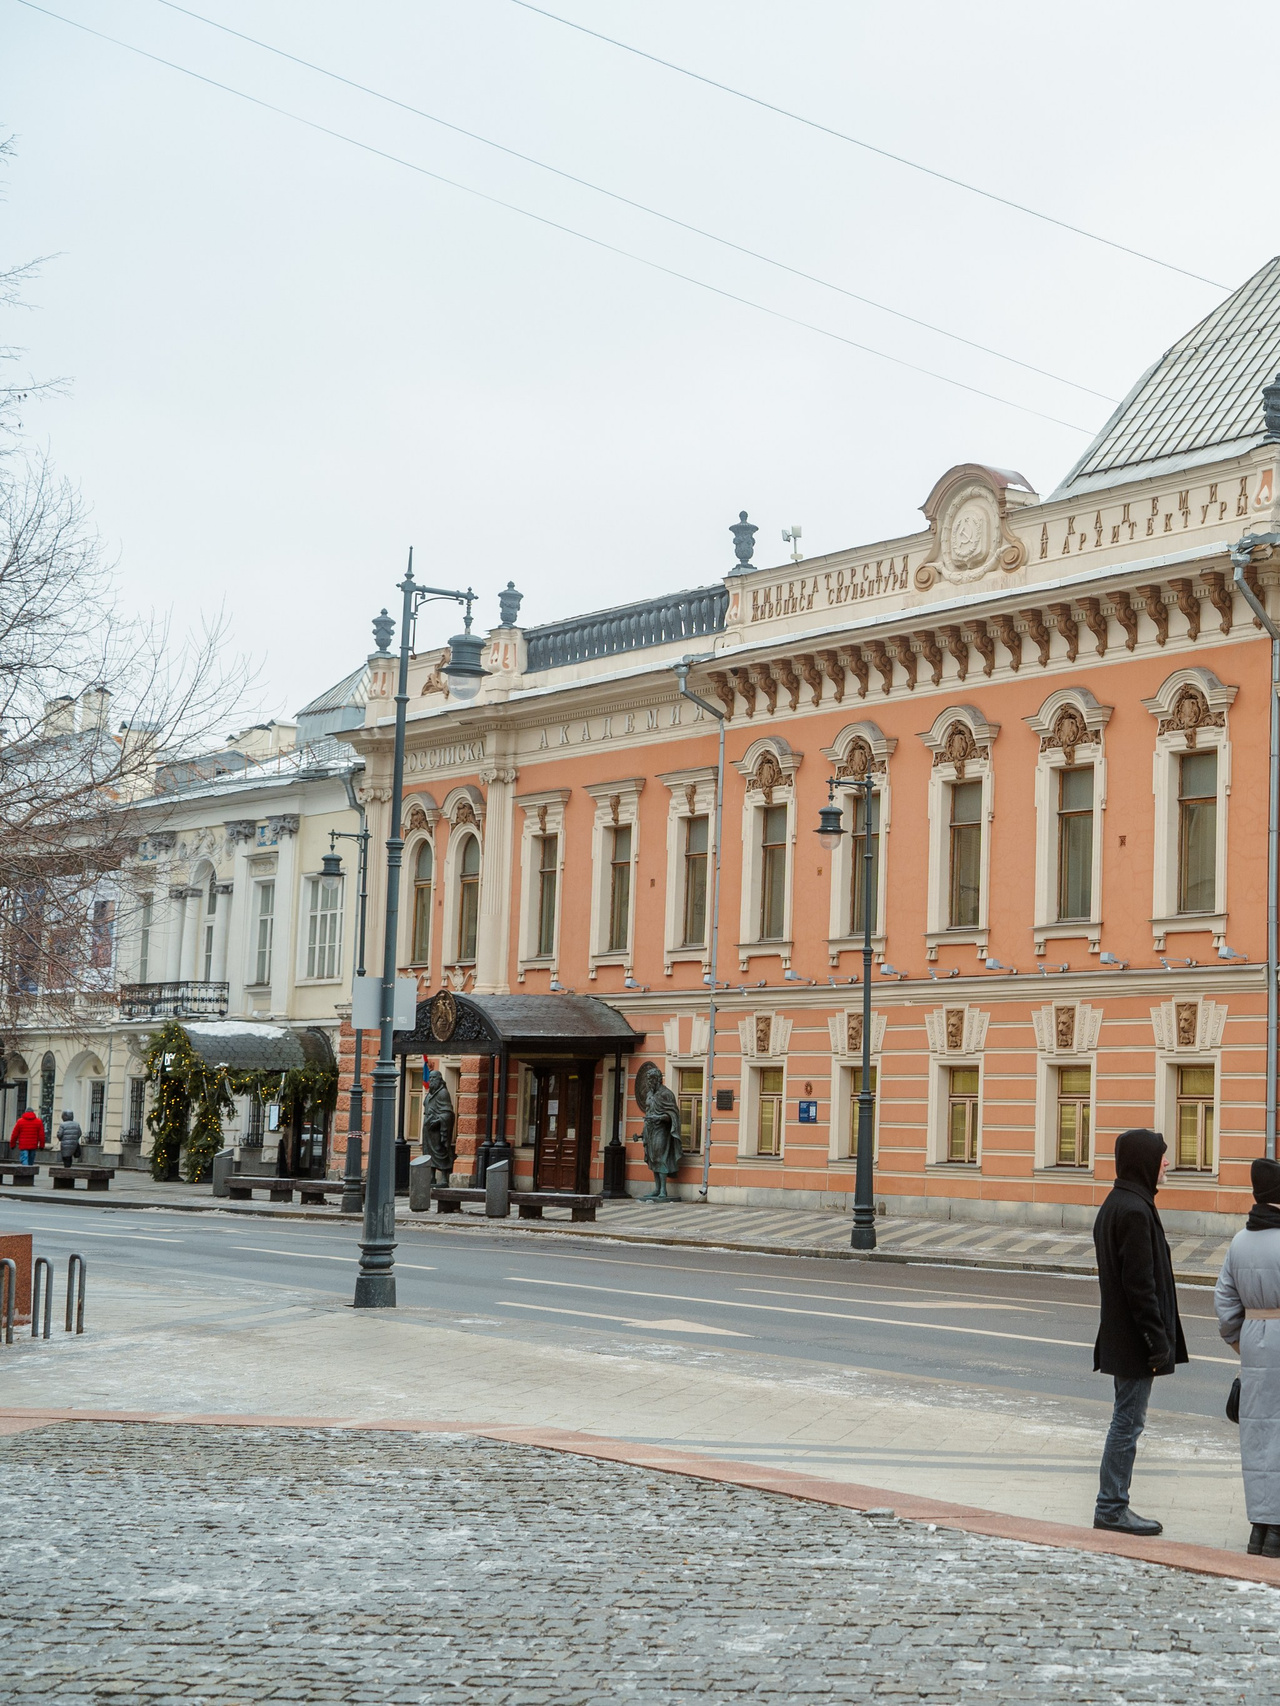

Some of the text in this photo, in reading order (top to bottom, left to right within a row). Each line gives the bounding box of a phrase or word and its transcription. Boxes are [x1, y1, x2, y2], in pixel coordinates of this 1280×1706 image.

[751, 495, 1249, 622] ЖИВОПИСИ СКУЛЬПТУРЫ И АРХИТЕКТУРЫ
[752, 476, 1248, 605] ИМПЕРАТОРСКАЯ АКАДЕМИЯ
[539, 704, 705, 749] АКАДЕМИЯ
